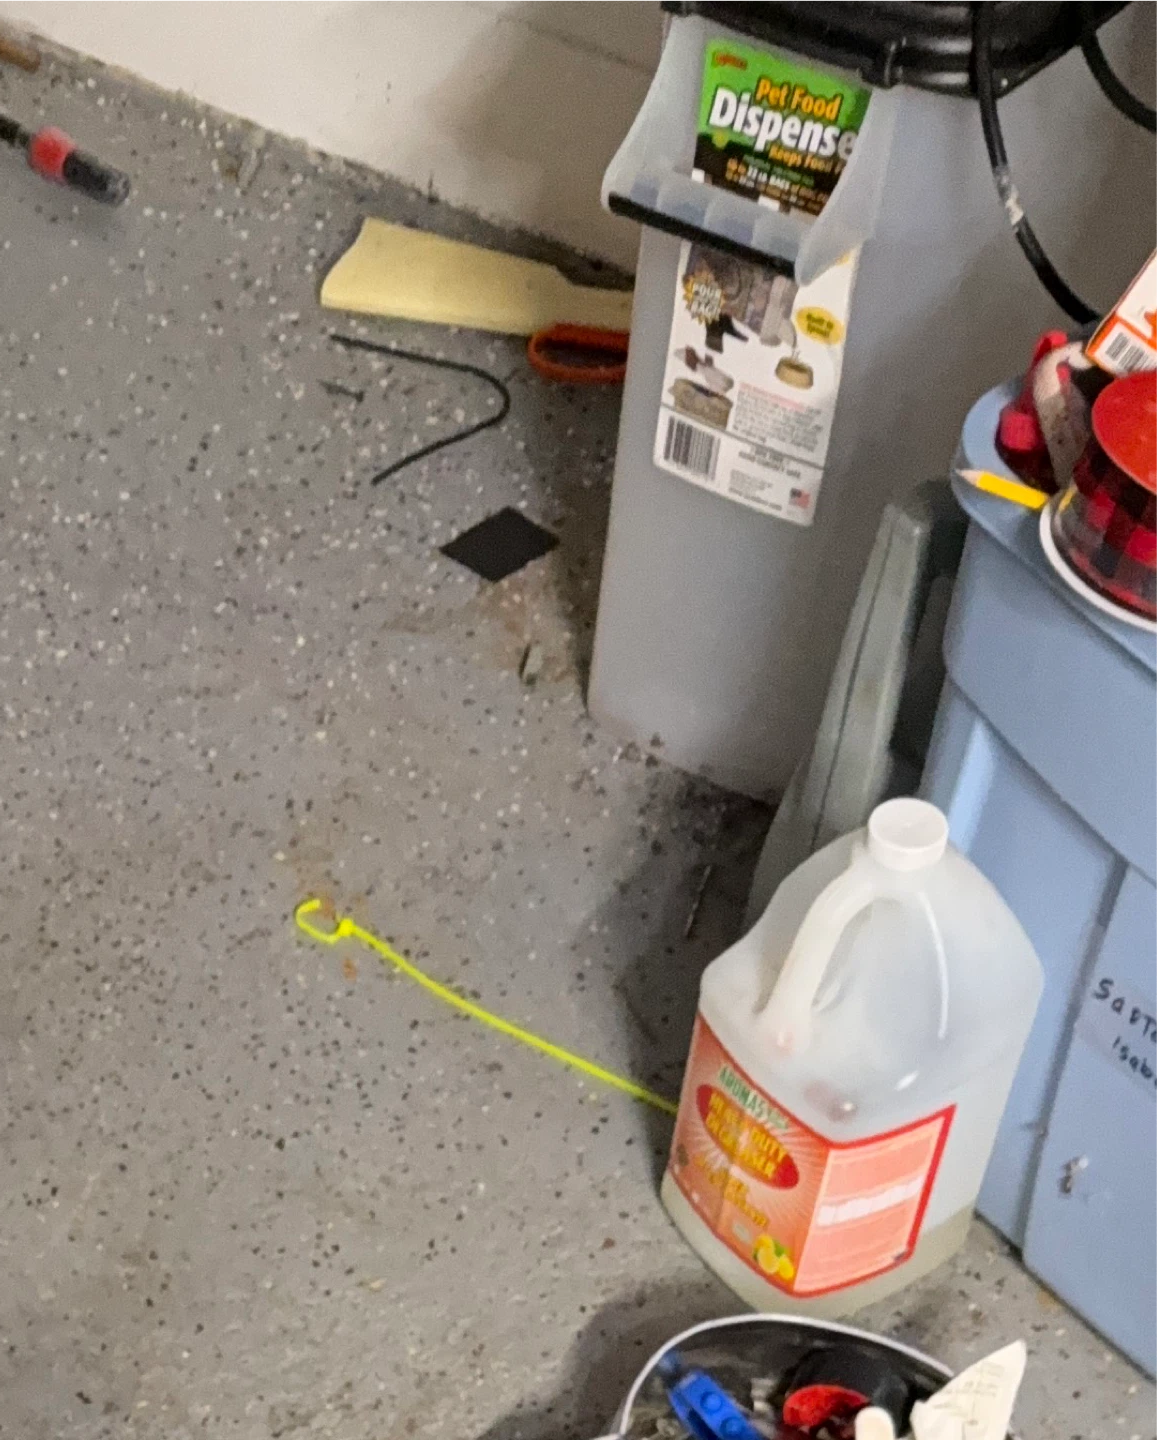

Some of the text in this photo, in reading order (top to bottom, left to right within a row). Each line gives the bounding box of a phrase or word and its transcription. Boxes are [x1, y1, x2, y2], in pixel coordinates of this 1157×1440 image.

[708, 87, 858, 161] Dispense
[755, 77, 842, 121] Pet Food
